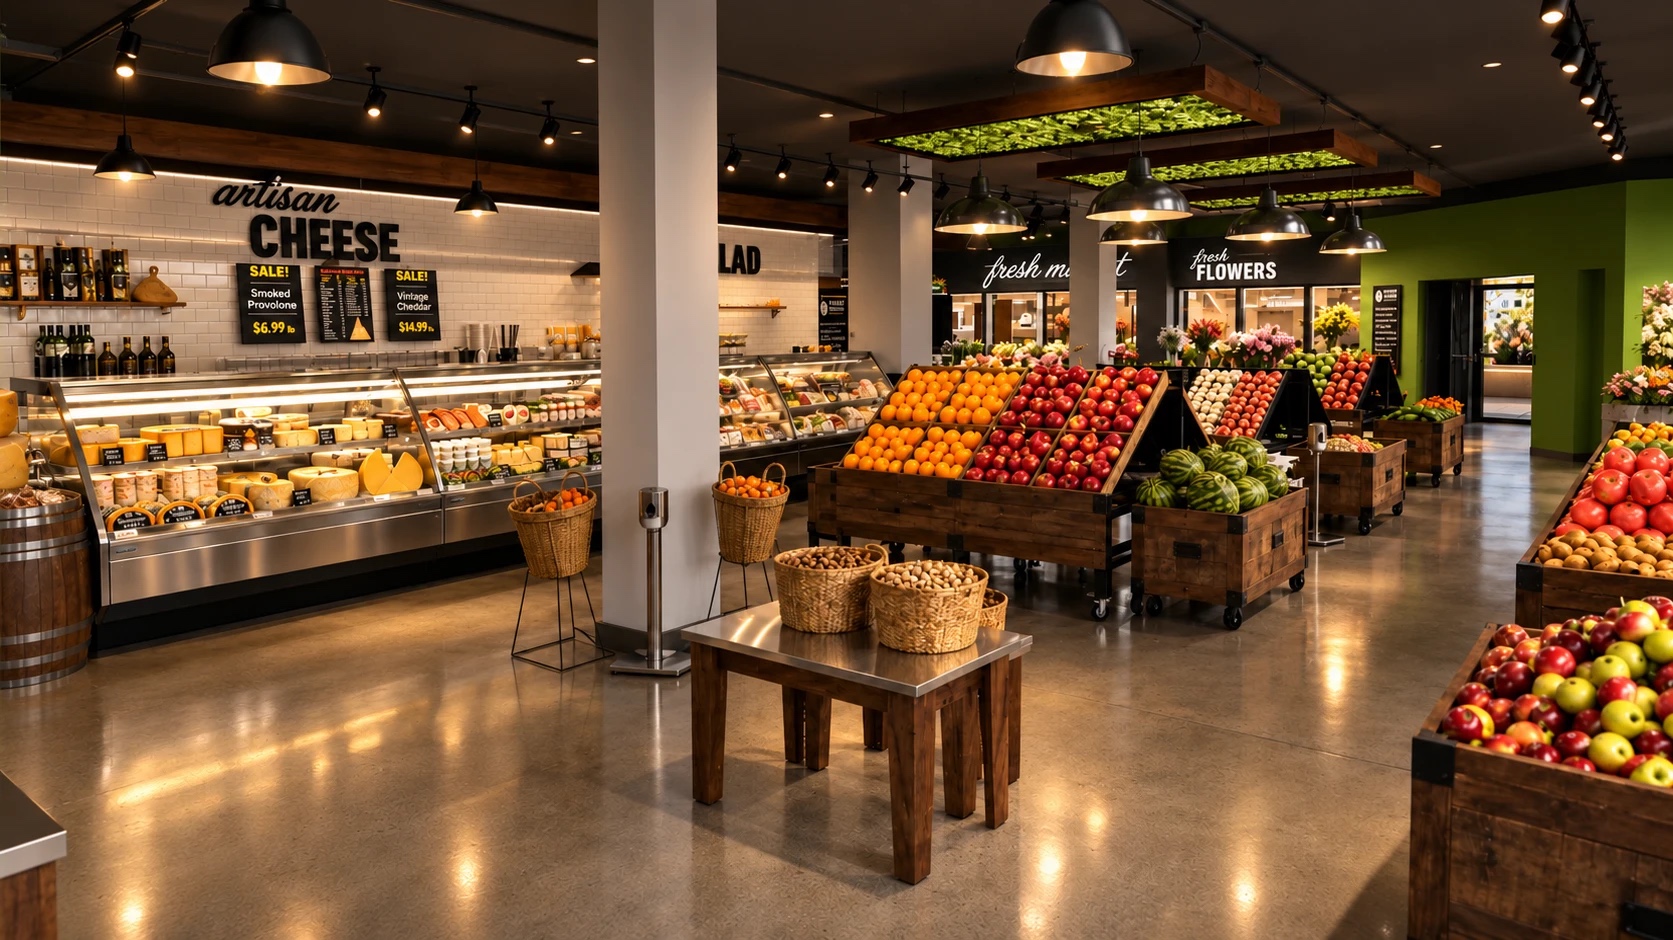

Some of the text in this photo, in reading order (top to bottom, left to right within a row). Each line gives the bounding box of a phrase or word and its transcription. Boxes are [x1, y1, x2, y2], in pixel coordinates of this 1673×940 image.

[212, 173, 340, 214] artisan
[250, 214, 401, 263] CHEESE
[718, 243, 761, 275] LAD
[1189, 247, 1230, 270] fresh
[249, 265, 289, 278] SALE!
[396, 270, 428, 282] SALE!
[983, 252, 1042, 289] fresh
[1196, 261, 1277, 281] FLOWERS
[250, 288, 291, 298] Smoked
[396, 291, 429, 302] Vintage
[247, 300, 297, 310] Provolone
[396, 302, 432, 311] Cheddar
[253, 321, 286, 335] $6.99
[398, 321, 428, 333] $14.99
